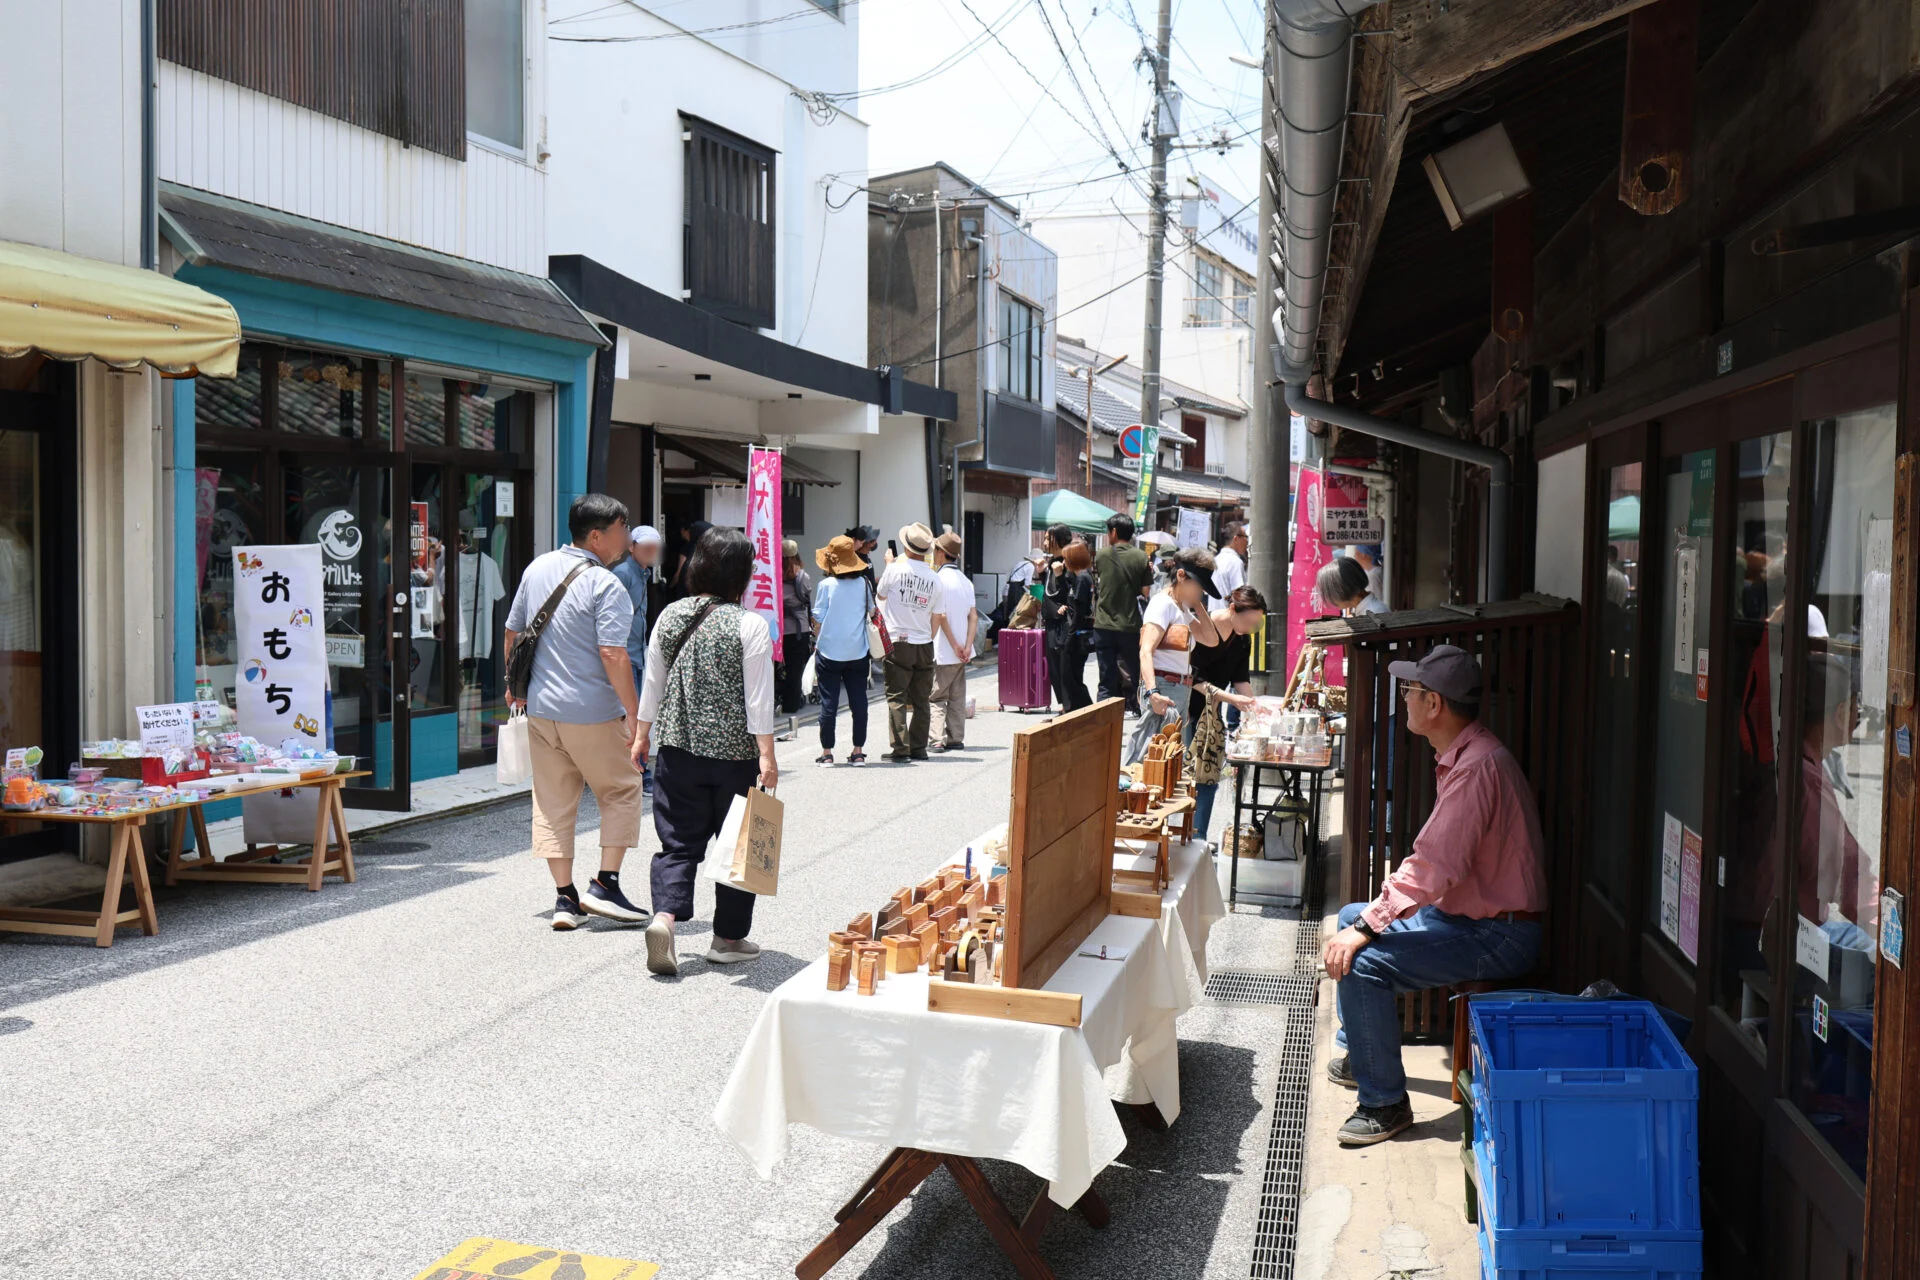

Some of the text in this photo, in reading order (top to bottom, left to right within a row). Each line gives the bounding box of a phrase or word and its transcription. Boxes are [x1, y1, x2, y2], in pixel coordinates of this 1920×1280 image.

[1326, 510, 1368, 519] ミヤケ毛糸
[752, 481, 774, 611] 大道芸
[325, 642, 356, 655] OPEN
